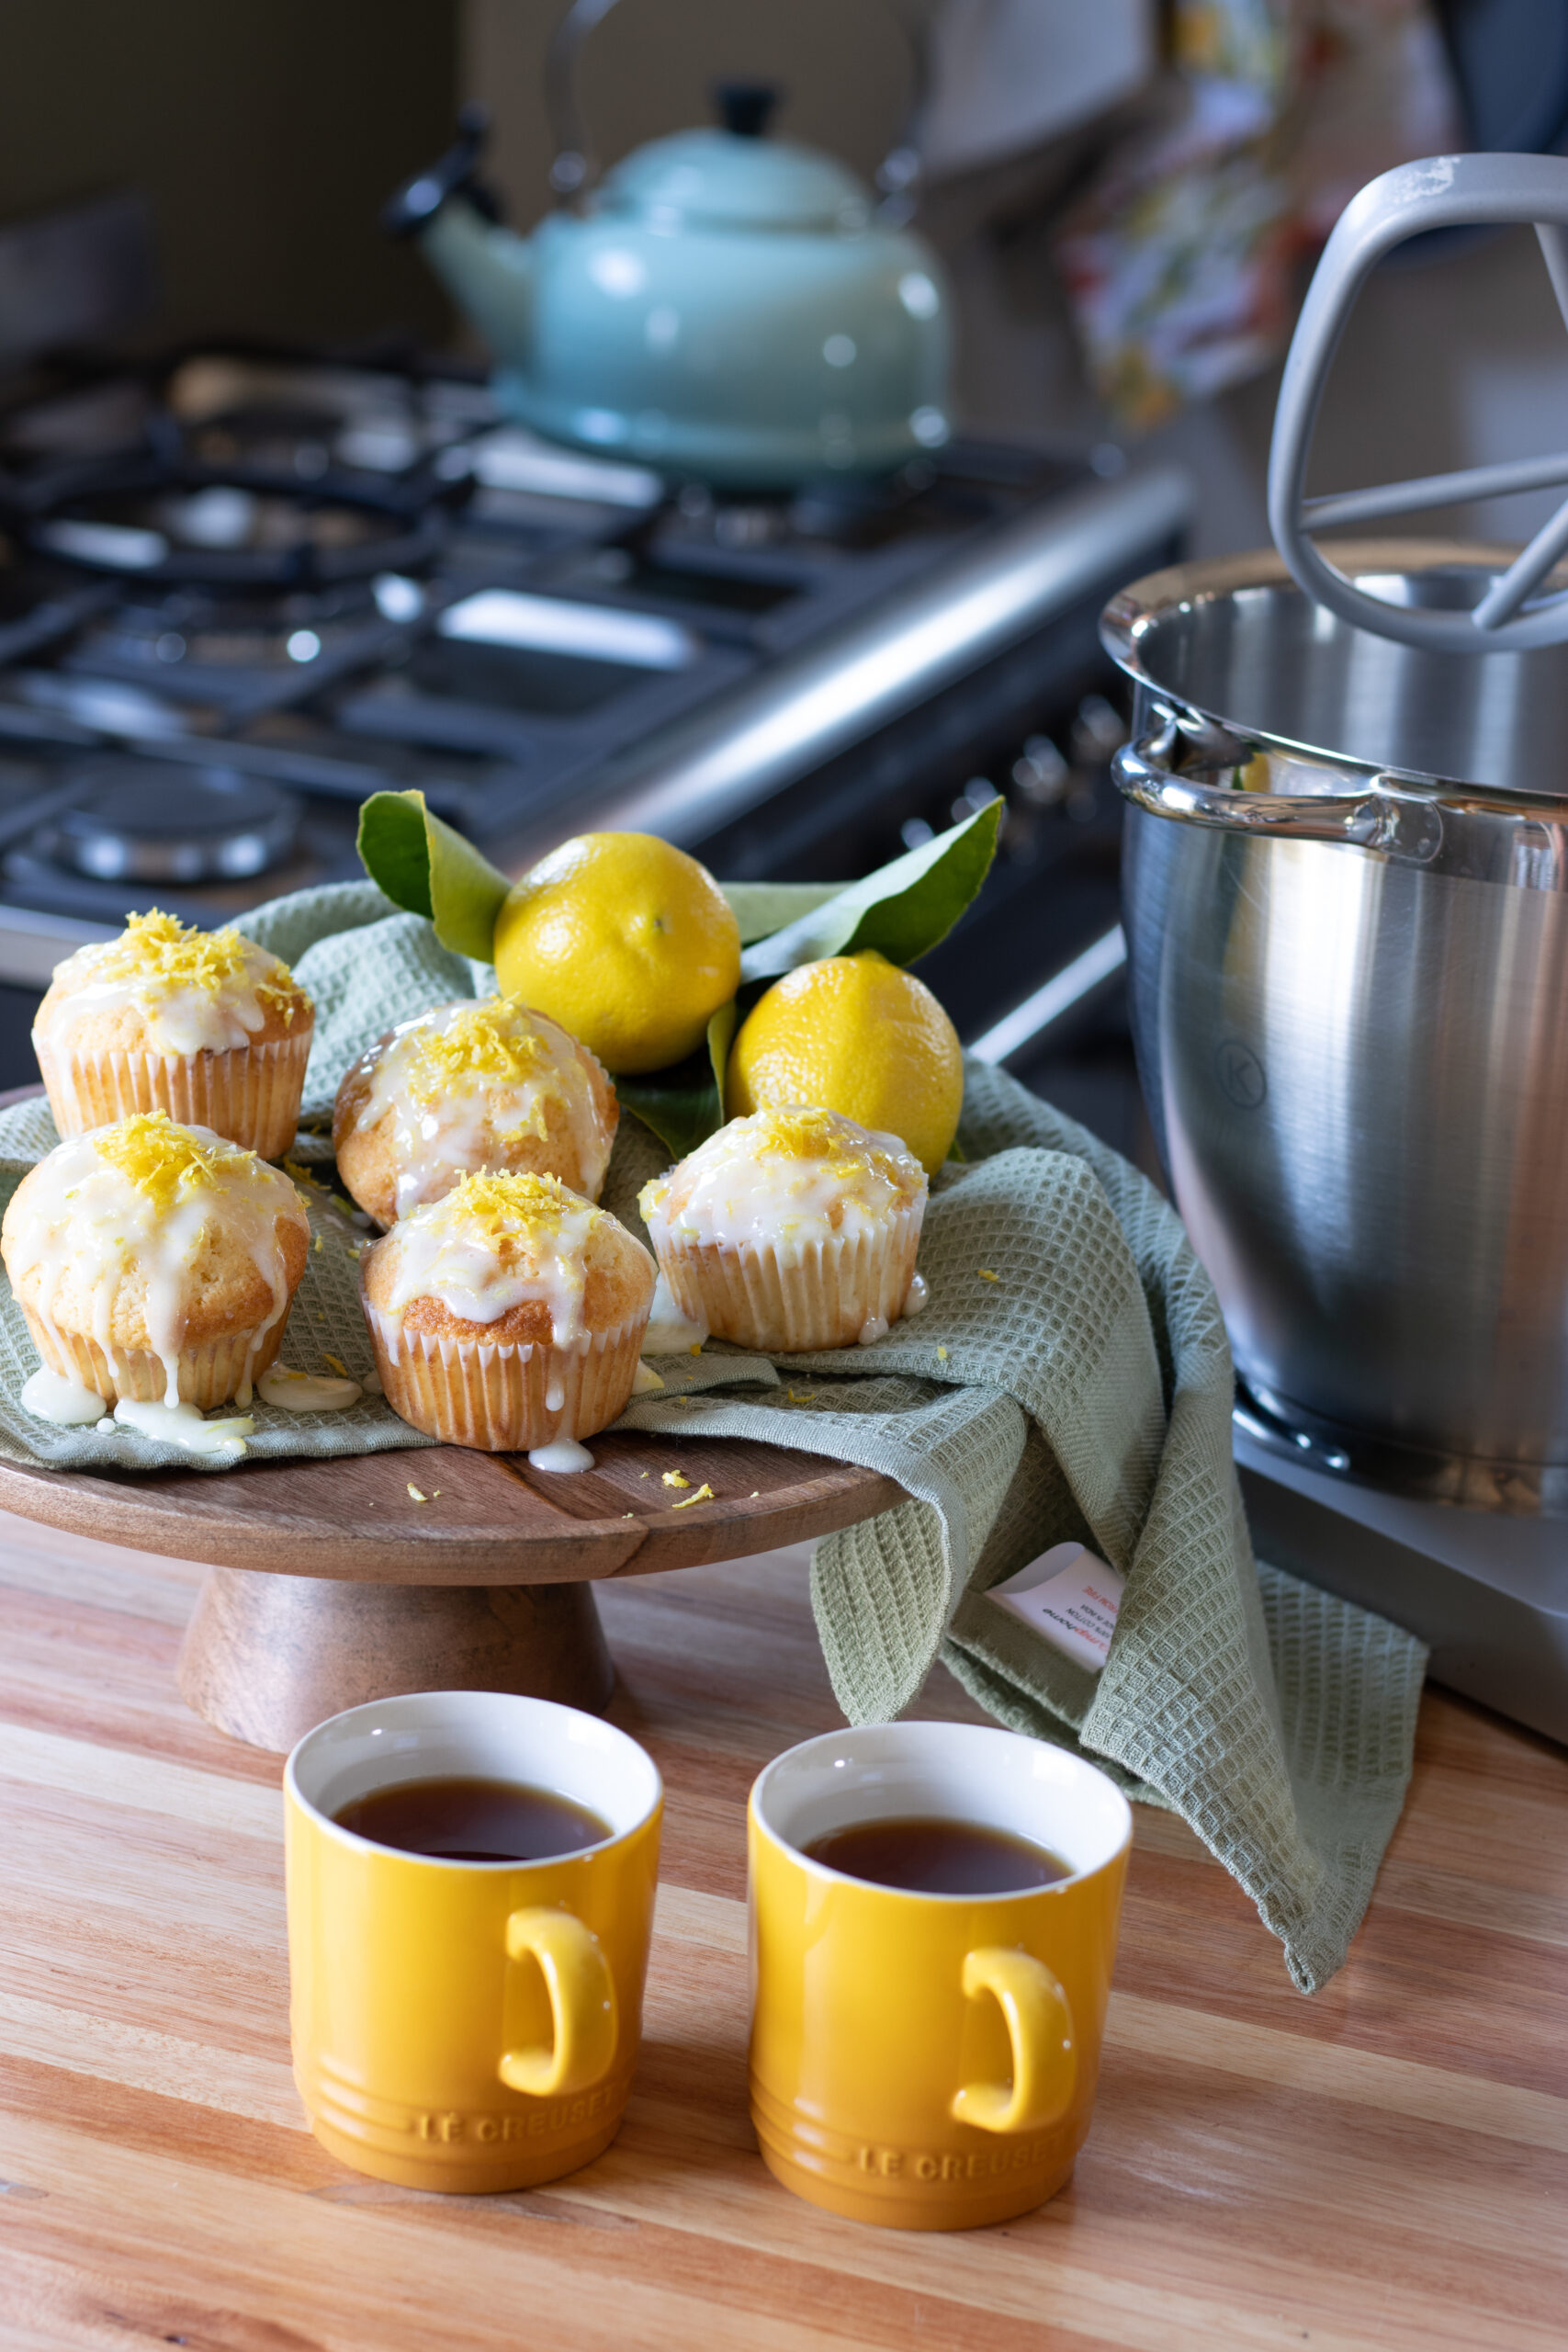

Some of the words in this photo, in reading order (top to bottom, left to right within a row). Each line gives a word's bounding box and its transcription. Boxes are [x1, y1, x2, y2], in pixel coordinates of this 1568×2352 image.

[1066, 1608, 1095, 1627] COTTON
[1080, 1604, 1097, 1617] INDIA
[477, 2085, 615, 2143] CREUSET
[859, 2145, 900, 2177] LE
